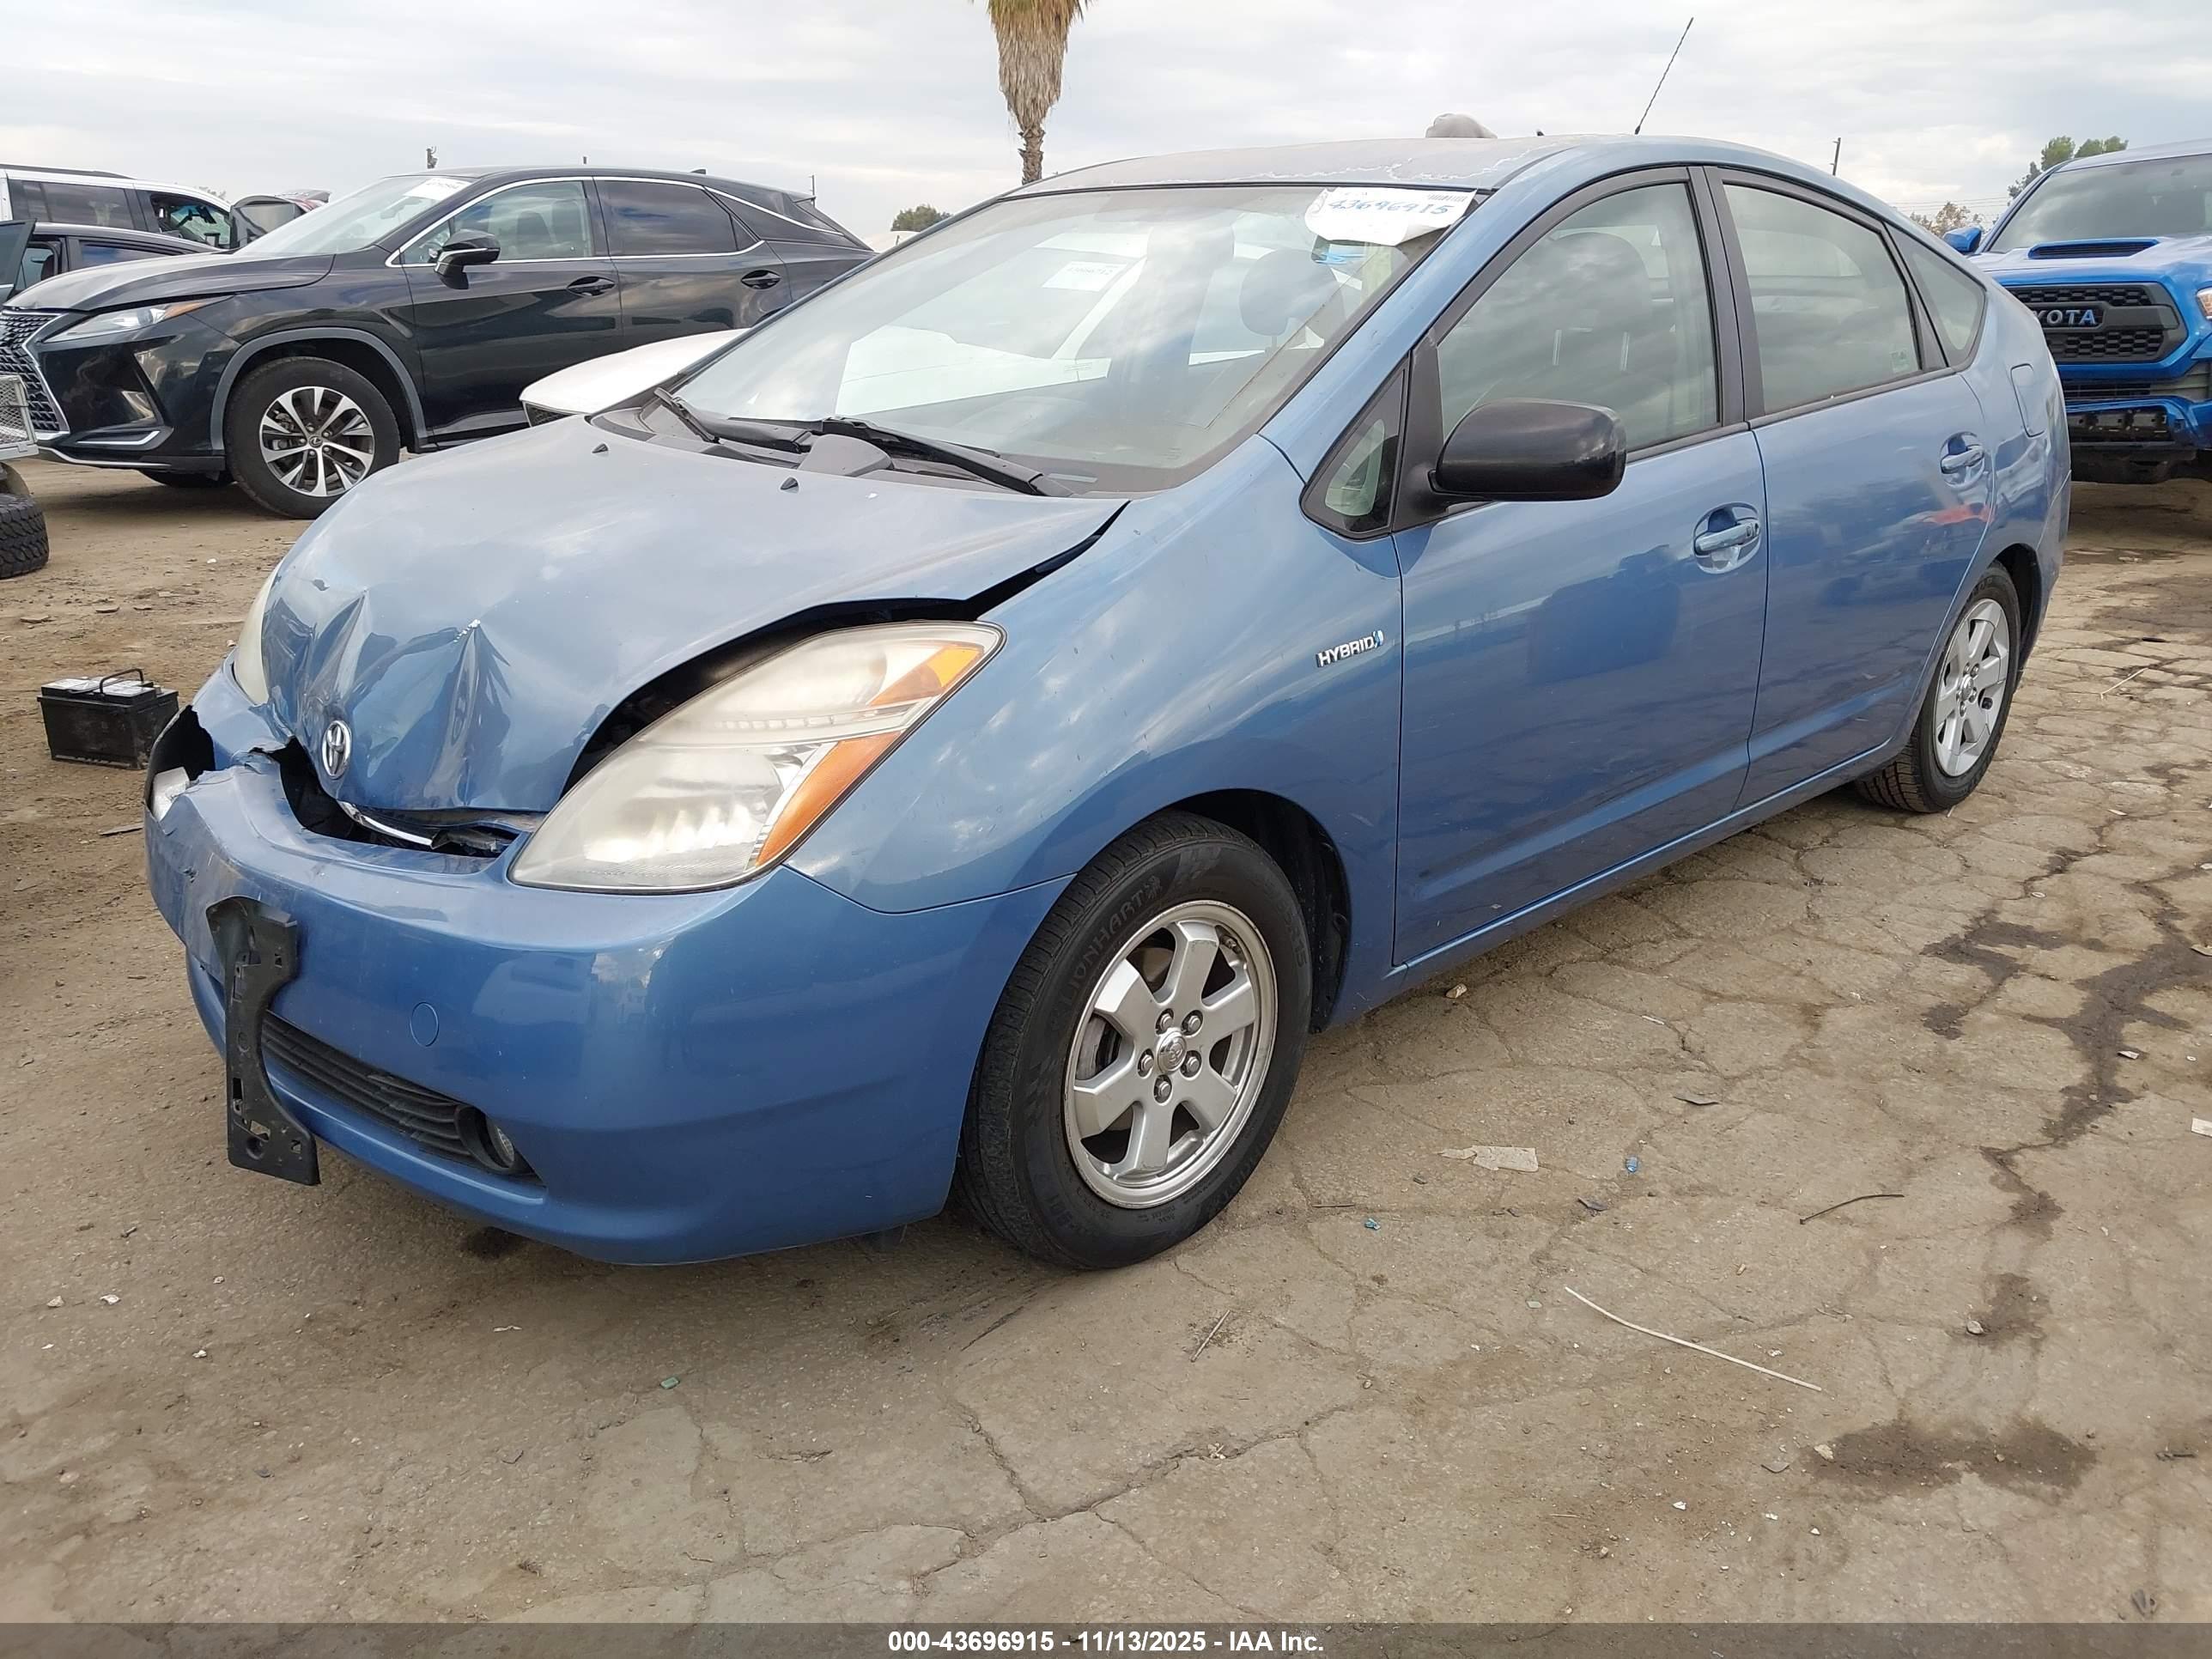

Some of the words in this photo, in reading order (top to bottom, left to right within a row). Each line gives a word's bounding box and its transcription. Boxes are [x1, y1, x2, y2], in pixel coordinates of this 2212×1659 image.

[2032, 309, 2097, 325] YOTA
[1316, 635, 1376, 667] HYBRID
[1060, 890, 1146, 1006] LIONHART
